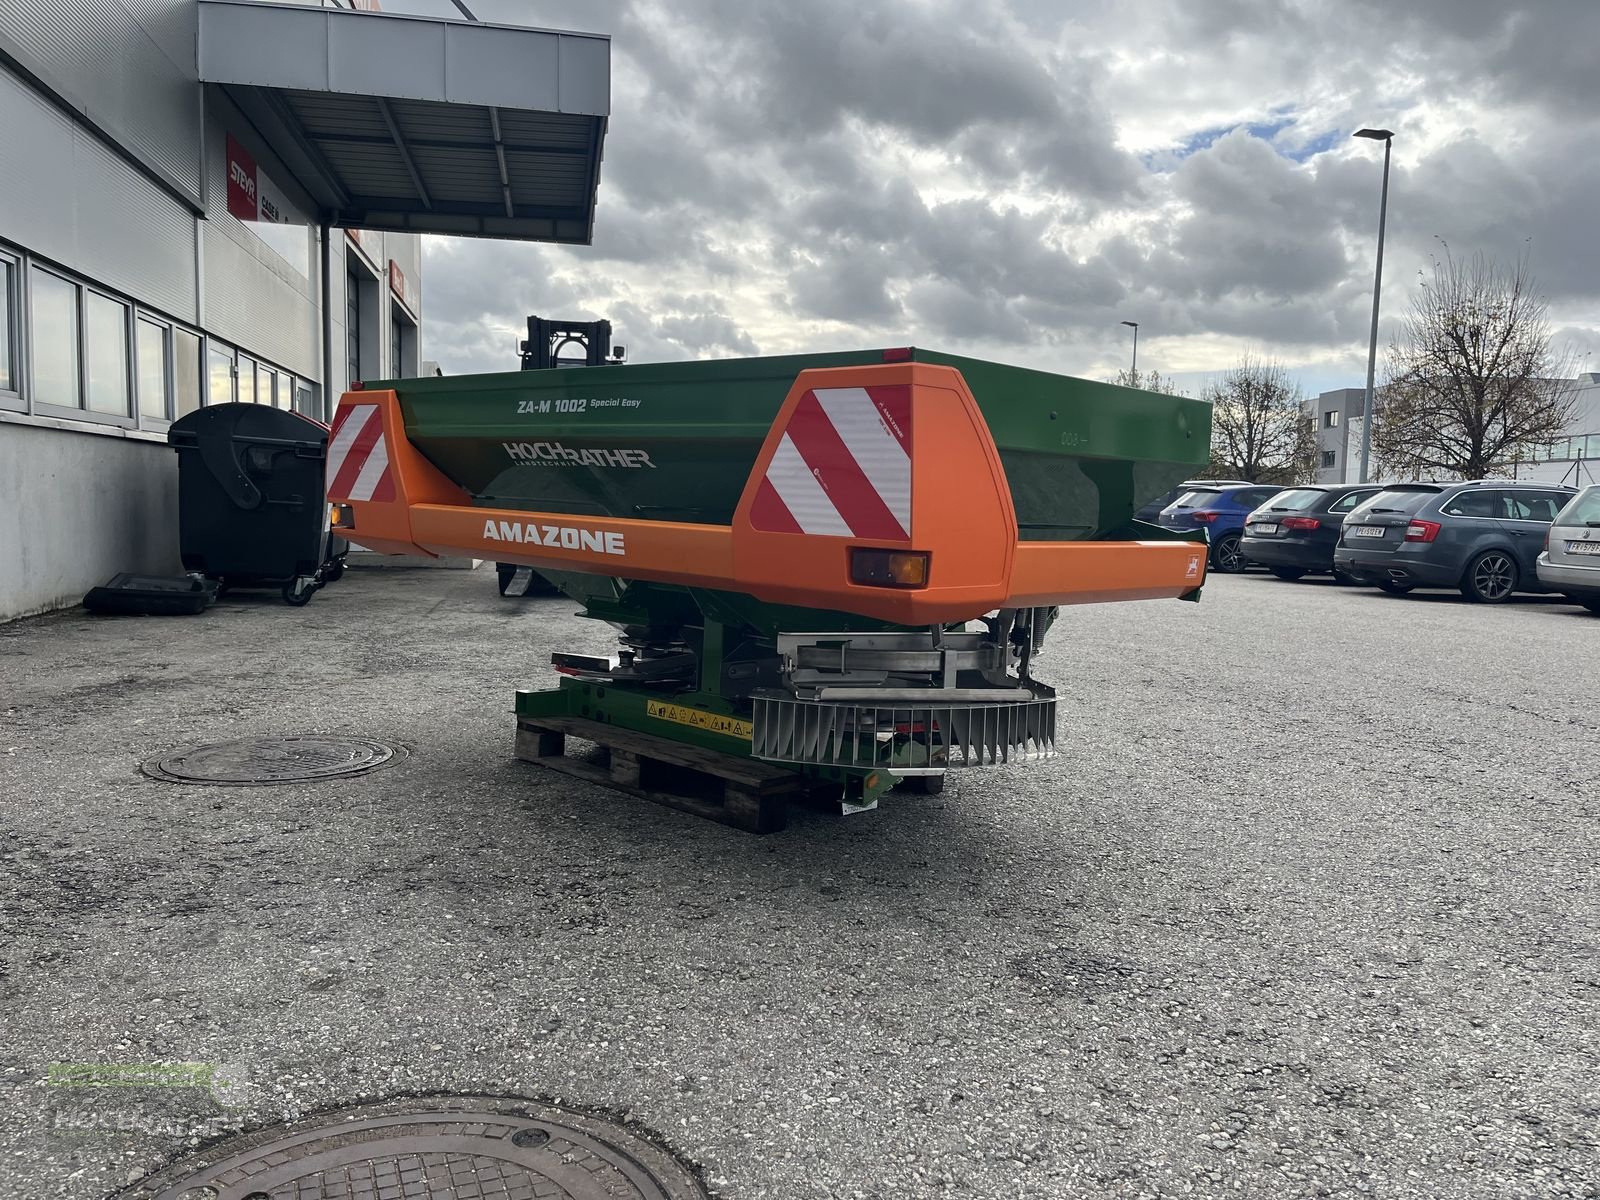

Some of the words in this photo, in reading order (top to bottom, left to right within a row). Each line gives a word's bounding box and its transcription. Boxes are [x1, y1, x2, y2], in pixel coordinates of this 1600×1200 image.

[231, 160, 255, 200] STEYR
[517, 400, 551, 413] ZA-M
[555, 399, 587, 413] 1002
[590, 398, 620, 408] Special
[621, 398, 642, 408] Easy
[882, 408, 905, 439] AMAZONE
[502, 442, 657, 469] HOCHRATHER
[483, 519, 625, 555] AMAZONE
